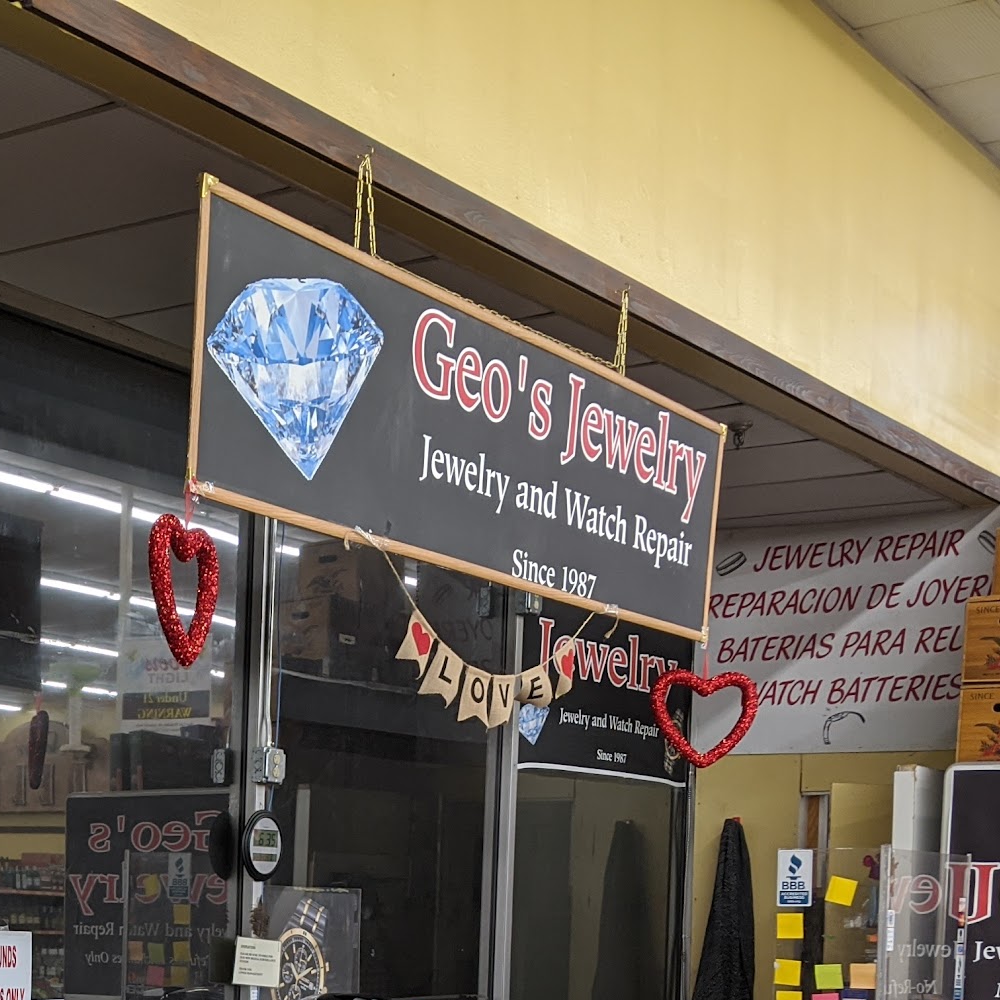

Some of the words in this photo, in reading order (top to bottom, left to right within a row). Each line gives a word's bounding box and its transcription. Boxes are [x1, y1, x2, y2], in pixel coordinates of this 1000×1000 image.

[412, 308, 553, 440] Geo's
[560, 373, 707, 524] Jewelry
[419, 434, 510, 514] Jewelry
[515, 481, 558, 519] and
[564, 488, 627, 545] Watch
[632, 514, 693, 569] Repair
[752, 536, 872, 573] JEWELRY
[873, 529, 965, 564] REPAIR
[511, 548, 556, 588] Since
[562, 566, 598, 600] 1987
[708, 585, 862, 619] REPARACION
[865, 582, 905, 610] DE
[716, 632, 836, 664] BATERIAS
[840, 627, 908, 658] PARA
[914, 625, 963, 654] REL
[438, 656, 544, 708] LOVE
[826, 673, 962, 706] BATTERIES
[559, 708, 590, 730] Jewelry
[592, 714, 608, 728] and
[609, 715, 633, 733] Watch
[634, 720, 660, 740] Repair
[596, 749, 613, 762] Since
[613, 751, 627, 764] 1987
[782, 881, 806, 890] BBB
